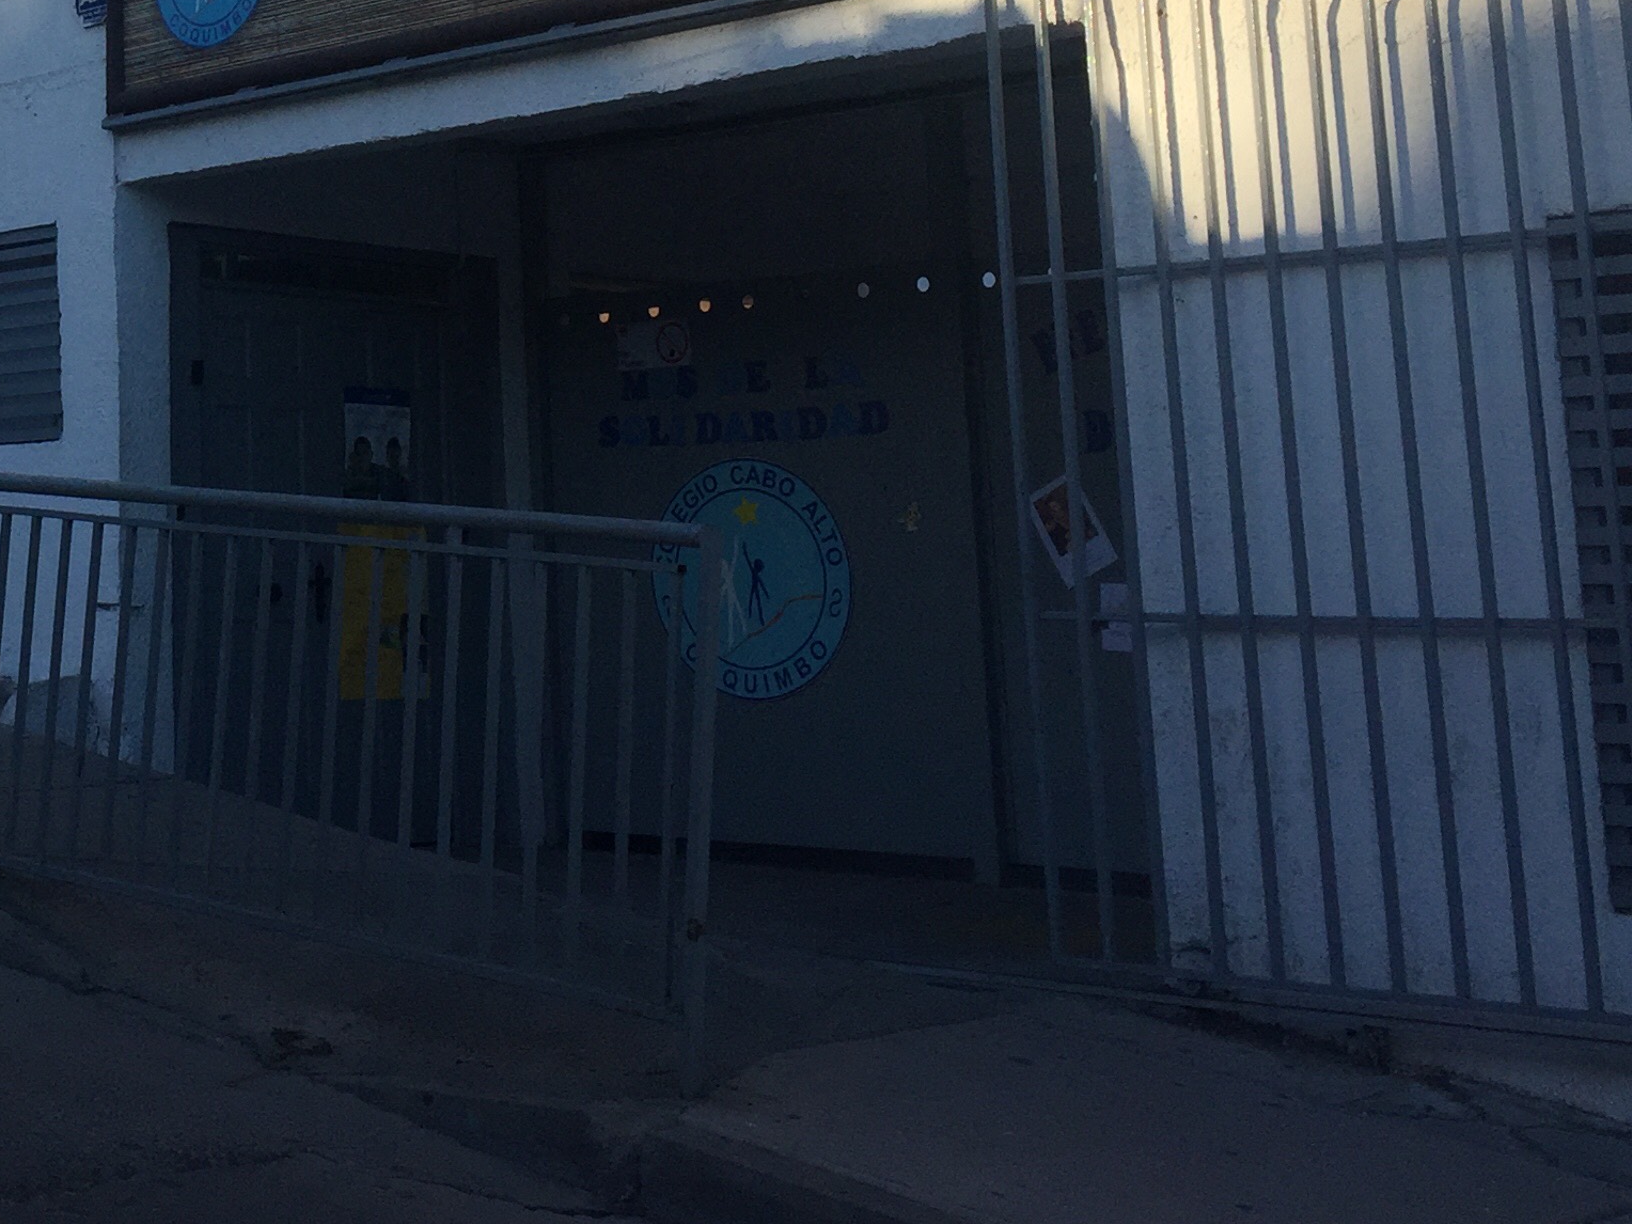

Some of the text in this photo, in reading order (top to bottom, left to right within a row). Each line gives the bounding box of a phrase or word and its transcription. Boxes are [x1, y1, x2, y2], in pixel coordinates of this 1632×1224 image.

[731, 464, 795, 497] CABO
[802, 501, 843, 566] ALTO
[686, 640, 827, 693] CQUIMBO
